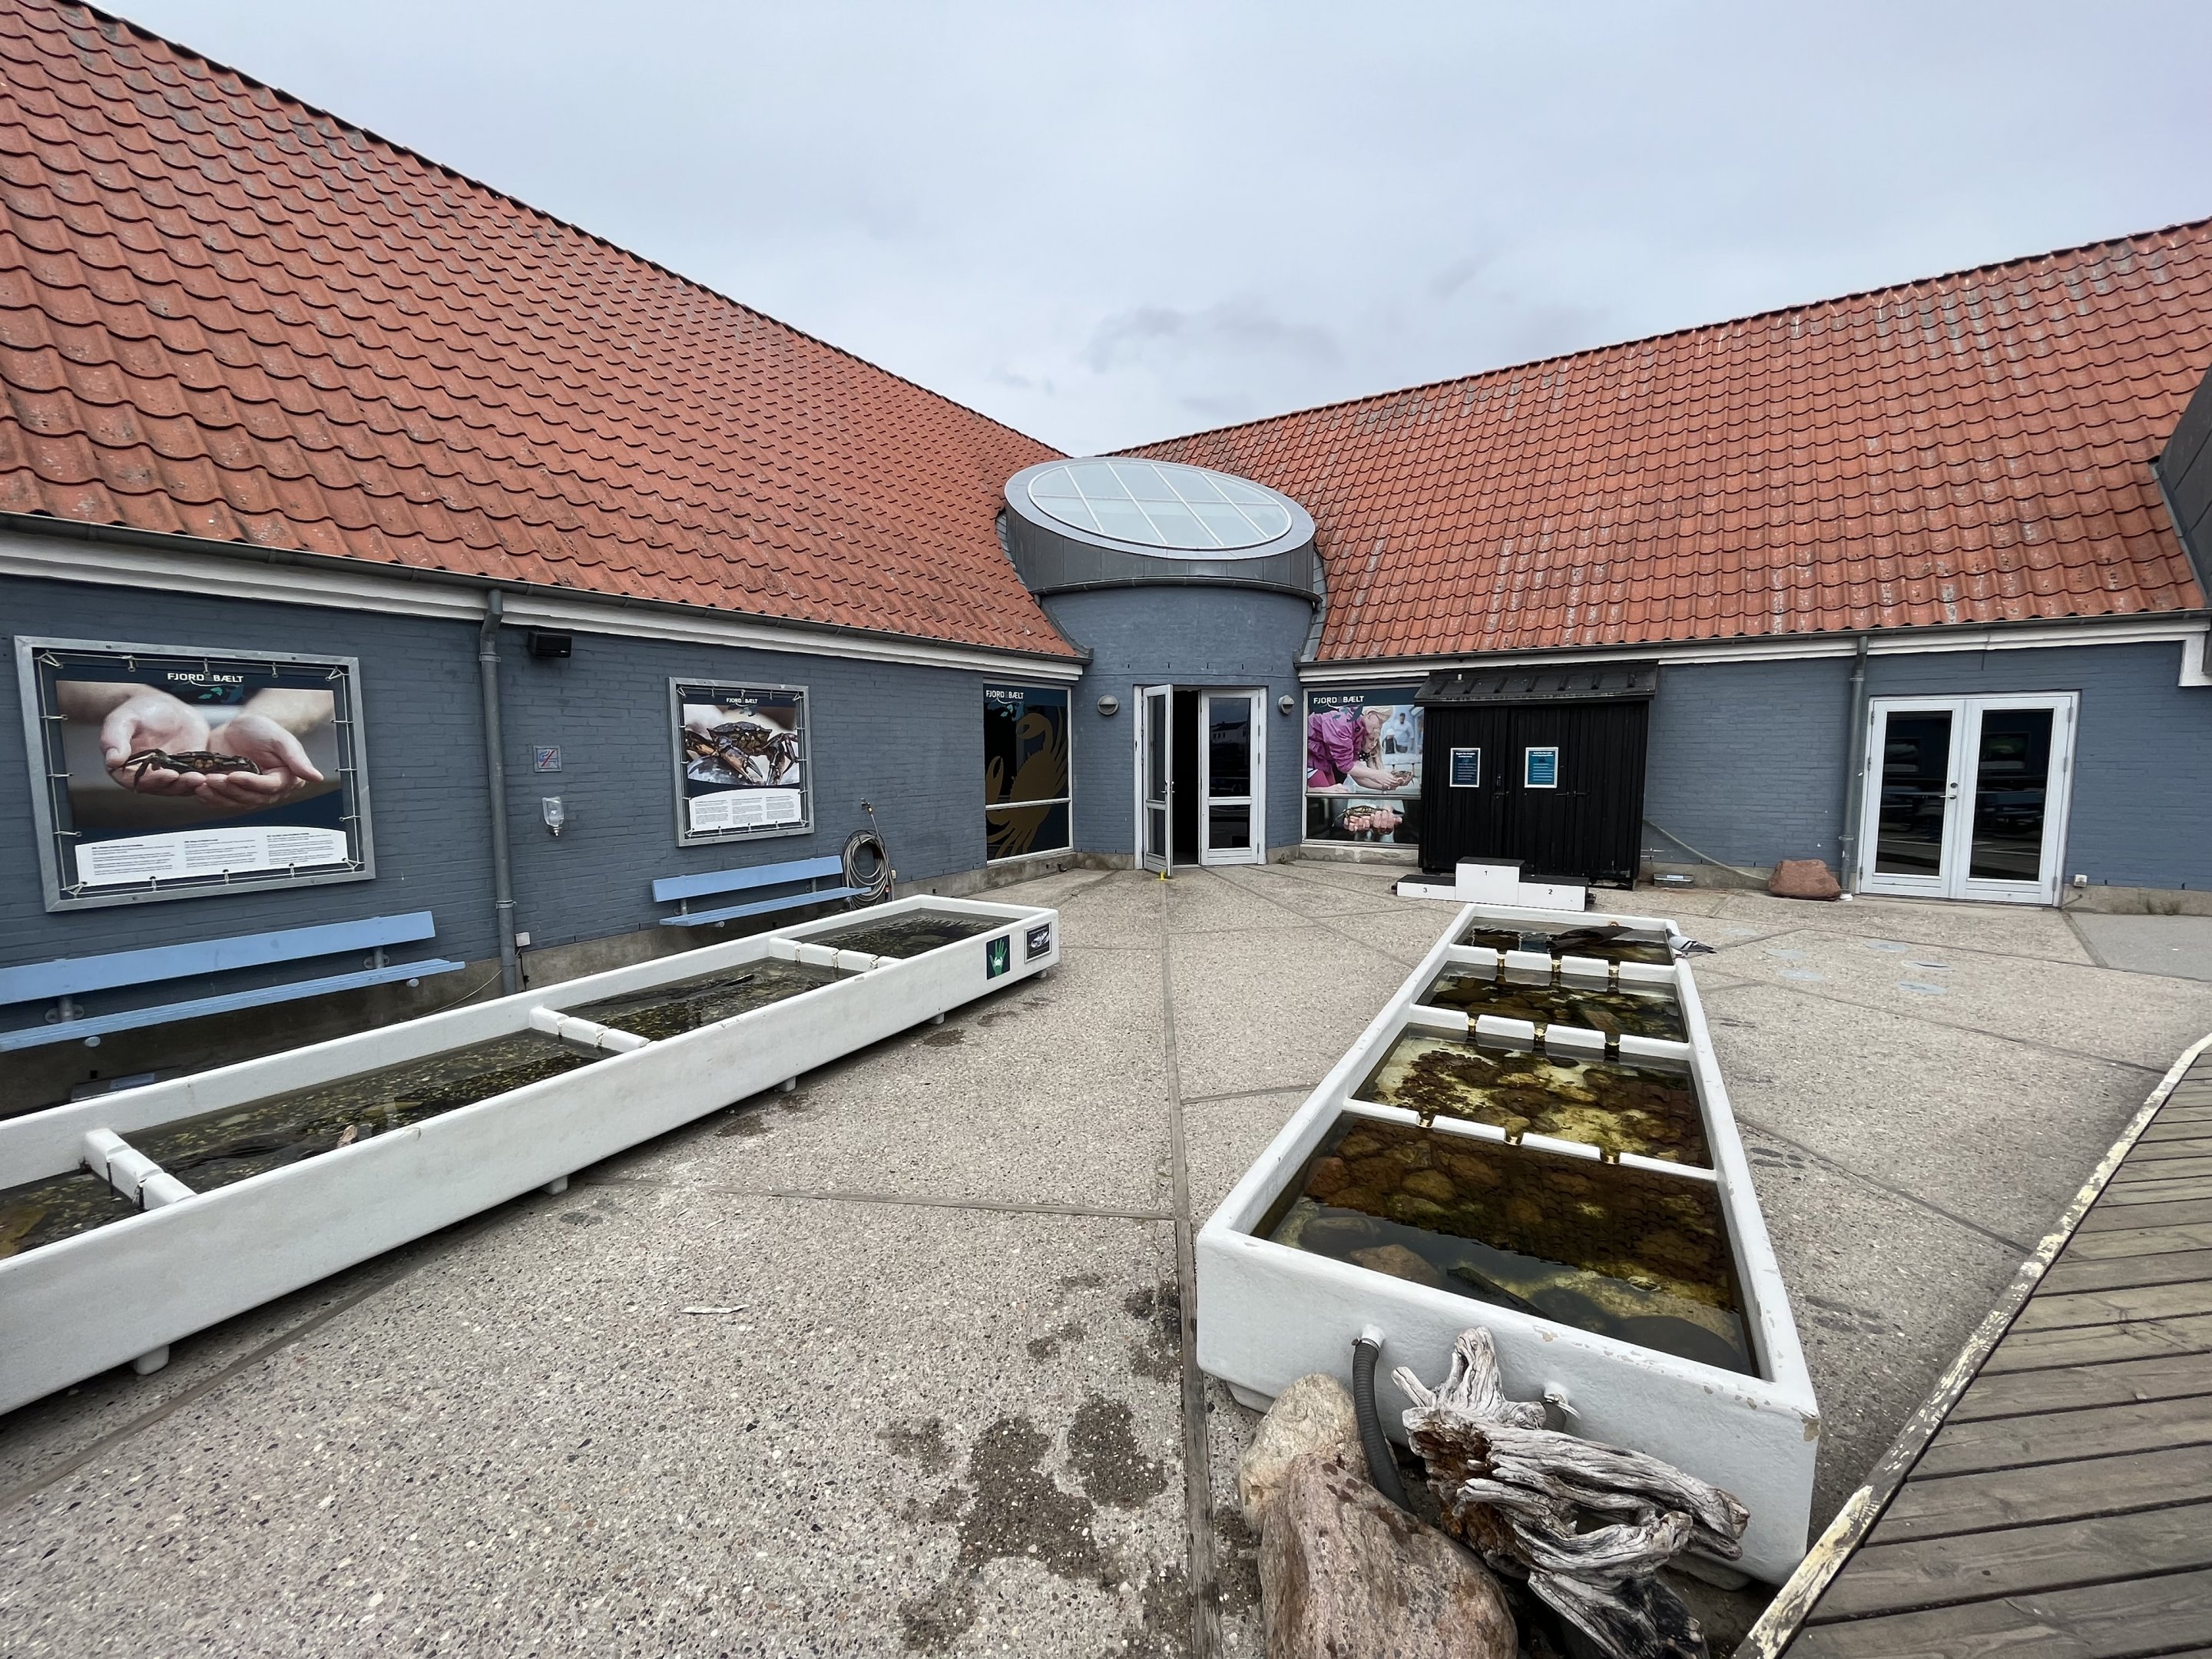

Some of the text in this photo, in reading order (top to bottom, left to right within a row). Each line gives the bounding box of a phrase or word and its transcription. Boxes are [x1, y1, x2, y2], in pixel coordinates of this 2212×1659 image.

[167, 673, 244, 683] FJORD BÆLT
[985, 690, 1025, 700] FJORD BÆLT
